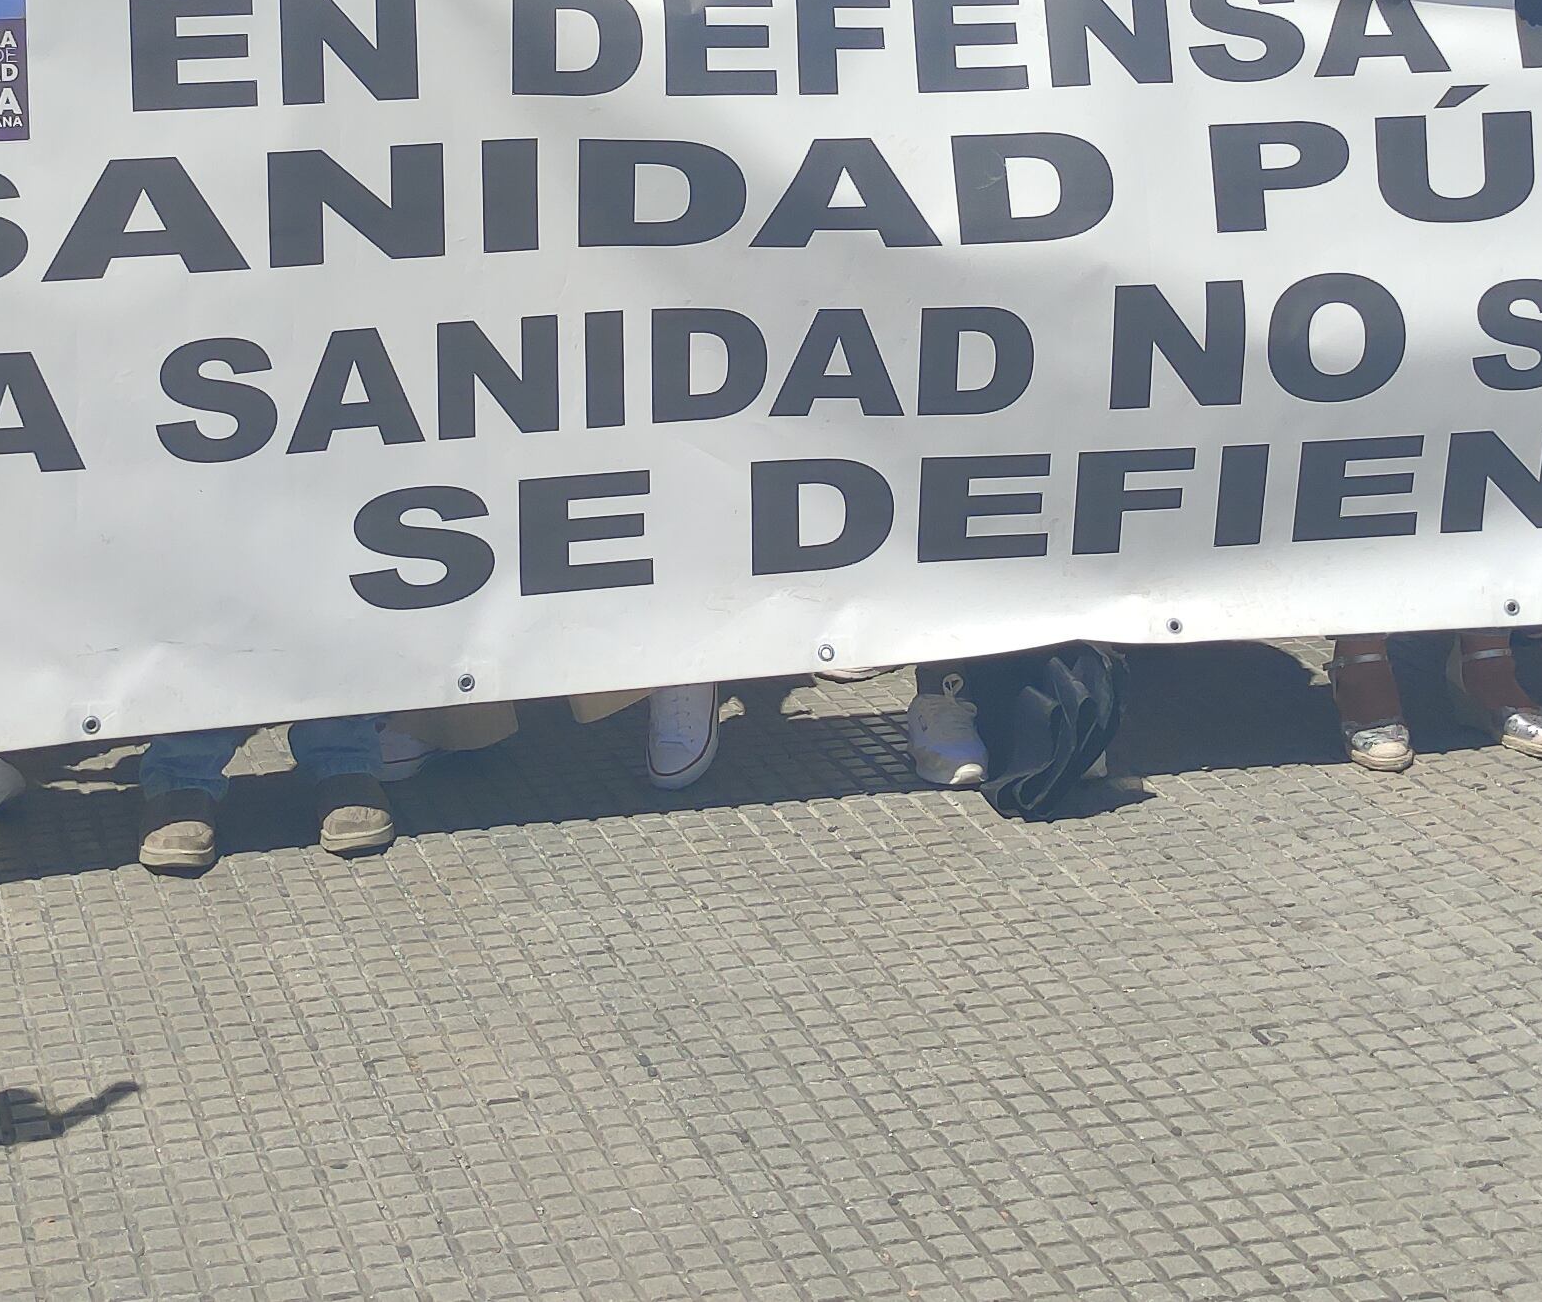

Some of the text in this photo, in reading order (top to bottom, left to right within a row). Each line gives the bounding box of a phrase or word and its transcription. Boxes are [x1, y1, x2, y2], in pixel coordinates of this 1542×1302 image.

[156, 307, 1035, 463] SANIDAD
[1109, 273, 1407, 409] NO
[349, 470, 655, 610] SE
